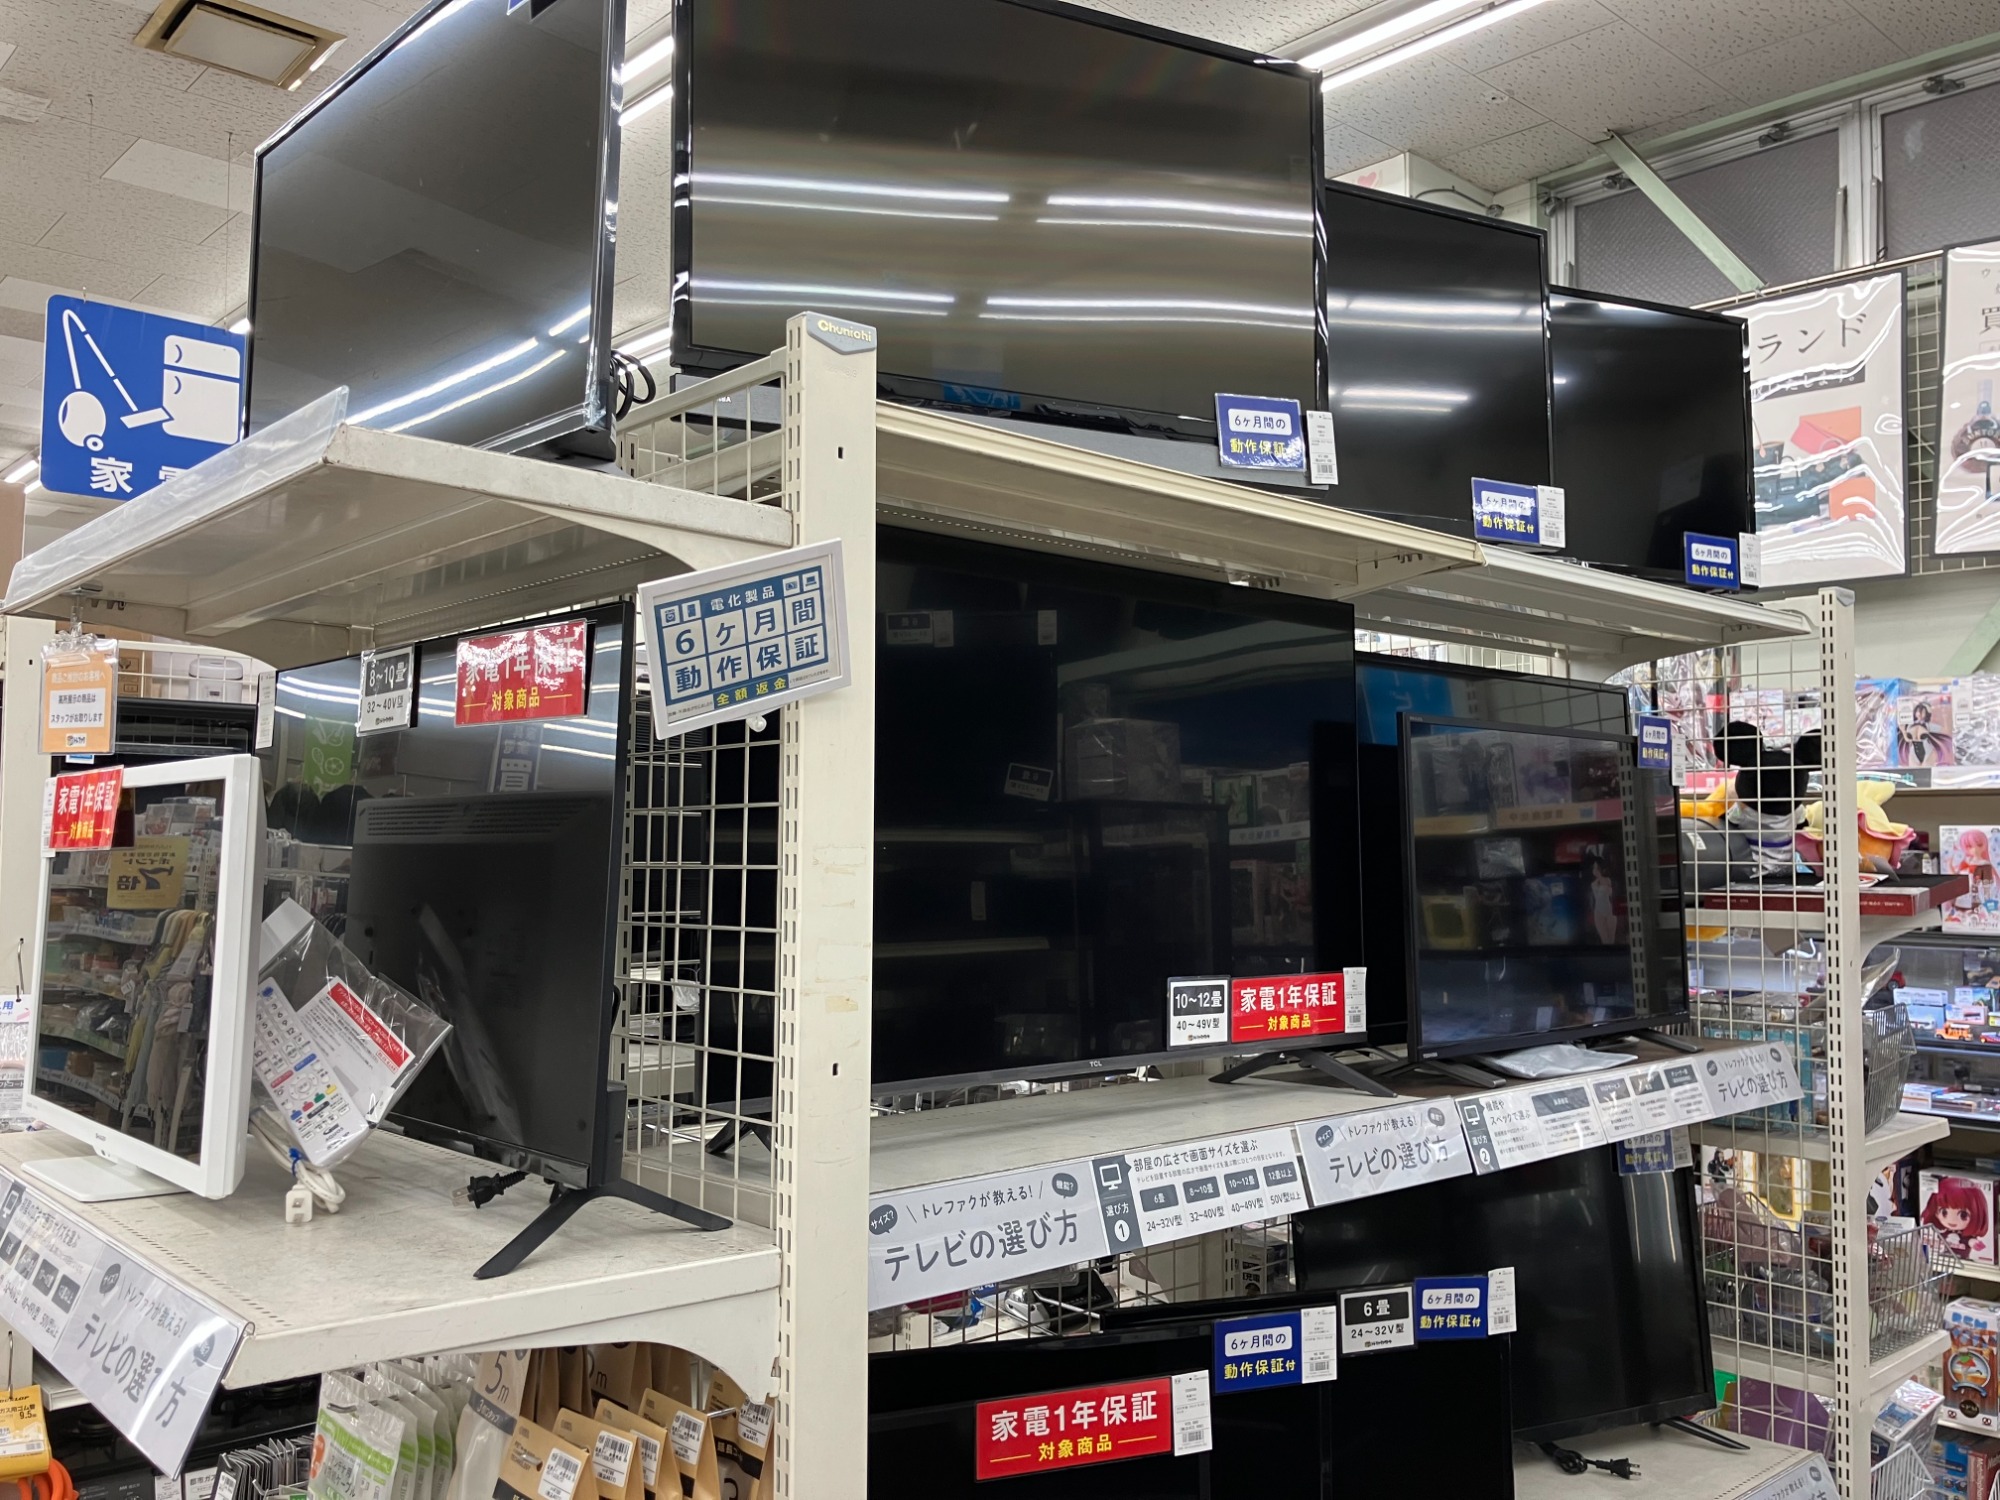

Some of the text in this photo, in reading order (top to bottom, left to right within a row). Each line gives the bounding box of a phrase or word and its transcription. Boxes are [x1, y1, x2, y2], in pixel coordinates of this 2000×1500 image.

[818, 320, 872, 342] Chunichi
[1482, 515, 1534, 533] 動作保証付
[710, 586, 775, 611] 電化製品
[675, 635, 819, 693] 動作保証
[491, 686, 540, 711] 対象商品
[716, 677, 787, 706] 全額返金
[51, 713, 102, 722] スタッフがお取りします
[58, 780, 116, 815] 家電1年保証
[1241, 982, 1337, 1013] 家電1年保証
[1268, 1014, 1311, 1031] 対象商品
[1718, 1069, 1788, 1102] テレビの選び方
[1348, 1116, 1417, 1138] トレファクが教える!
[1491, 1110, 1530, 1126] スペックで選ぶ
[1133, 1140, 1258, 1172] 部屋の広さで画面サイズを選ぶ
[1330, 1135, 1448, 1183] テレビの選び方
[1482, 1151, 1488, 1162] 2
[1268, 1168, 1293, 1181] 12畳以上
[922, 1185, 1032, 1219] トレファクが教える!
[1106, 1203, 1129, 1217] 選び方
[1270, 1193, 1301, 1205] 50V型以上
[870, 1210, 894, 1229] サイズ?
[1119, 1224, 1125, 1238] 1
[885, 1209, 1077, 1281] テレビの選び方
[125, 1282, 188, 1337] トレファクが教える!
[1364, 1298, 1391, 1317] 6畳
[1420, 1314, 1481, 1329] 動作保証付
[1224, 1358, 1296, 1379] 動作保証付
[991, 1390, 1157, 1442] 家電1年保証
[1038, 1434, 1112, 1462] 対象商品
